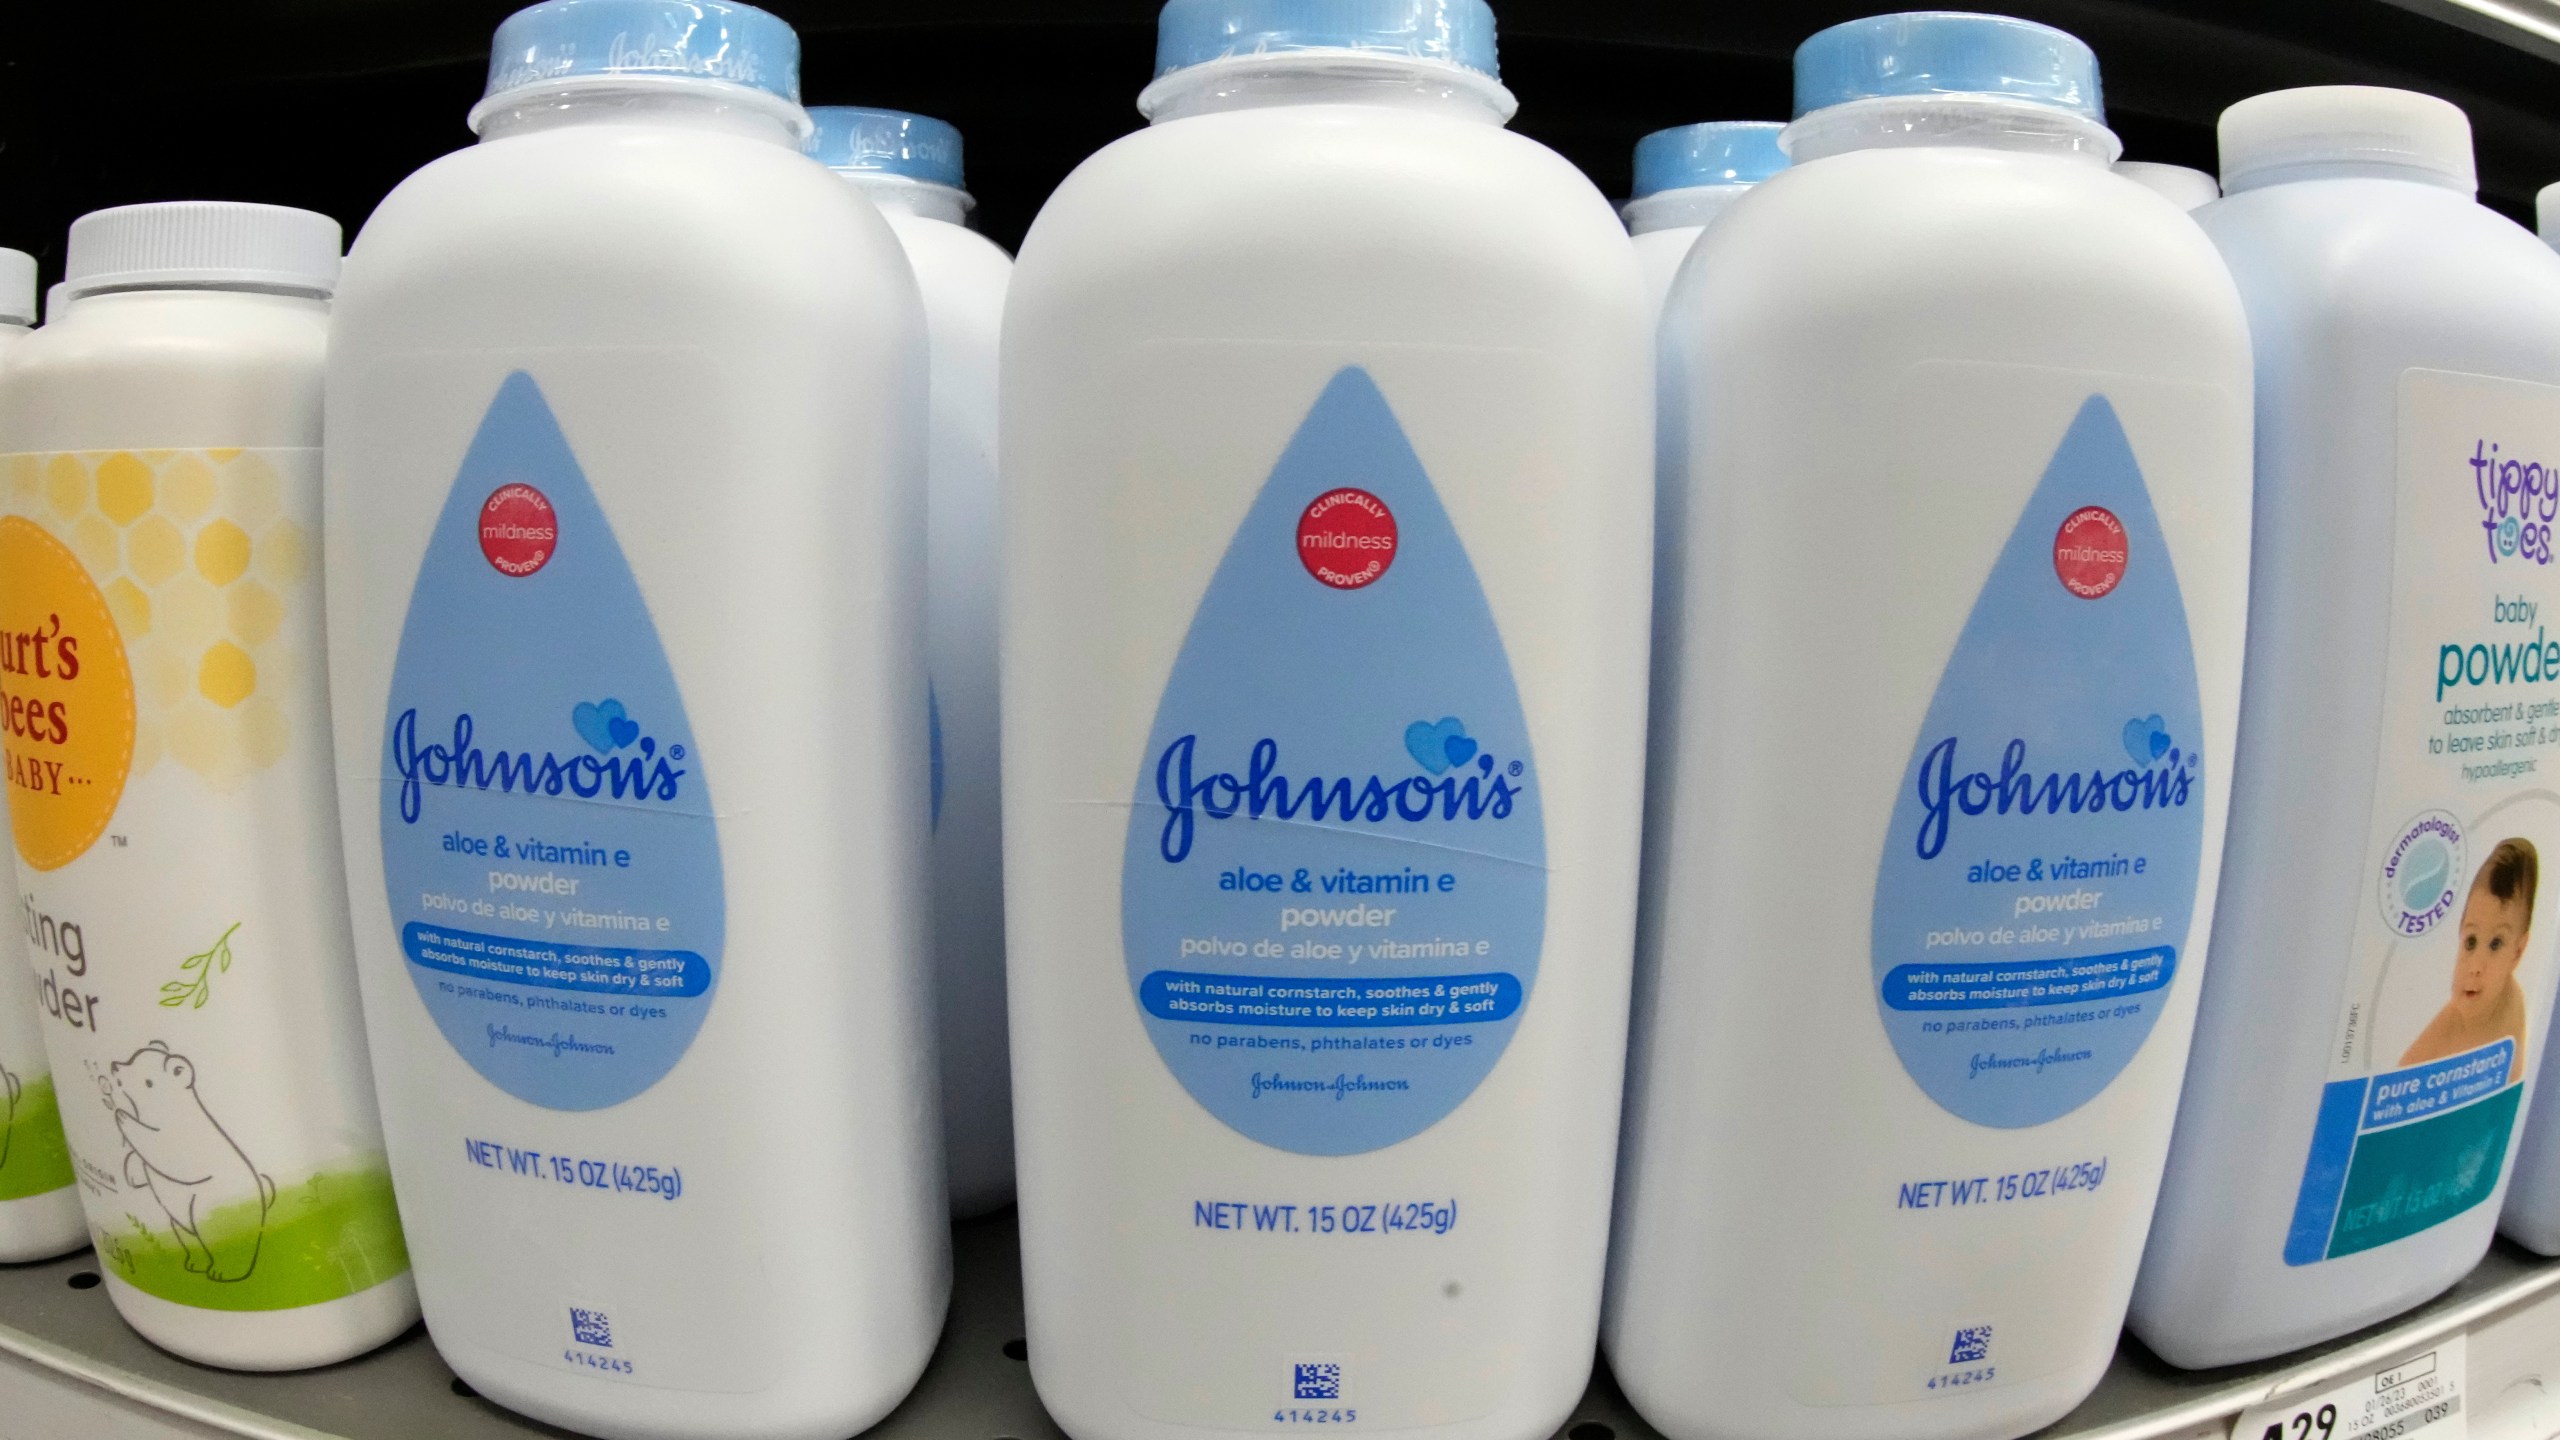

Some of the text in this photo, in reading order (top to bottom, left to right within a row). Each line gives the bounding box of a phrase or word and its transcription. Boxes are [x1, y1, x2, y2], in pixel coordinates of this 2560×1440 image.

[2469, 439, 2559, 522] tippy
[489, 488, 547, 511] CLINICALLY
[1310, 493, 1385, 518] CLINICALLY
[483, 523, 554, 539] mildness
[2065, 511, 2120, 534] CLINICALLY
[1302, 531, 1392, 550] mildness
[2058, 546, 2124, 562] mildness
[2495, 594, 2538, 629] baby
[2444, 702, 2513, 725] absorbent
[2428, 735, 2443, 754] to
[2447, 732, 2484, 753] leave
[2487, 731, 2513, 750] skin
[2515, 726, 2536, 748] soft
[443, 831, 630, 867] aloe & vitamin e
[2385, 816, 2460, 878] dermatologist
[1219, 867, 1455, 894] aloe & vitamin e
[1967, 853, 2146, 883] aloe & vitamin e
[489, 870, 579, 896] powder
[422, 892, 670, 932] polvo de aloe y vitamina e
[1281, 904, 1396, 931] powder
[2014, 889, 2103, 918] powder
[2398, 890, 2453, 933] TESTED
[1926, 916, 2162, 949] polvo de aloe vitamina e
[417, 929, 684, 972] with natural cornstarch, soothes & gently
[1181, 937, 1489, 963] polvo de aloe y vitamina e
[422, 947, 684, 987] absorbs moisture to keep skin dry & soft
[1908, 954, 2163, 983] with natural cornstarch, soothes gently
[439, 981, 666, 1019] no parabens, phthalates or dyes
[1166, 980, 1498, 1000] with natural cornstarch, soothes & gently
[1908, 970, 2159, 1001] absorbs moisture to keep skin dry soft
[1169, 998, 1495, 1019] absorbs moisture to keep skin dry & soft
[1923, 1003, 2140, 1034] no parabens, phthalates or dyes
[1190, 1032, 1472, 1051] no parabens, phthalates or dyes
[2376, 1048, 2506, 1104] pure cornstarch
[2373, 1105, 2402, 1120] with
[2407, 1096, 2435, 1112] aloe
[2494, 1071, 2502, 1084] E
[466, 1137, 681, 1200] NET WT. 15 OZ (425g)
[1898, 1156, 2107, 1209] NET WT. 15 OZ (425g)
[1195, 1199, 1457, 1234] NET WT. 15 OZ (425g)
[565, 1350, 633, 1374] 414245
[1928, 1367, 1995, 1389] 414245
[1274, 1410, 1356, 1423] 414245
[2425, 1402, 2448, 1423] 039
